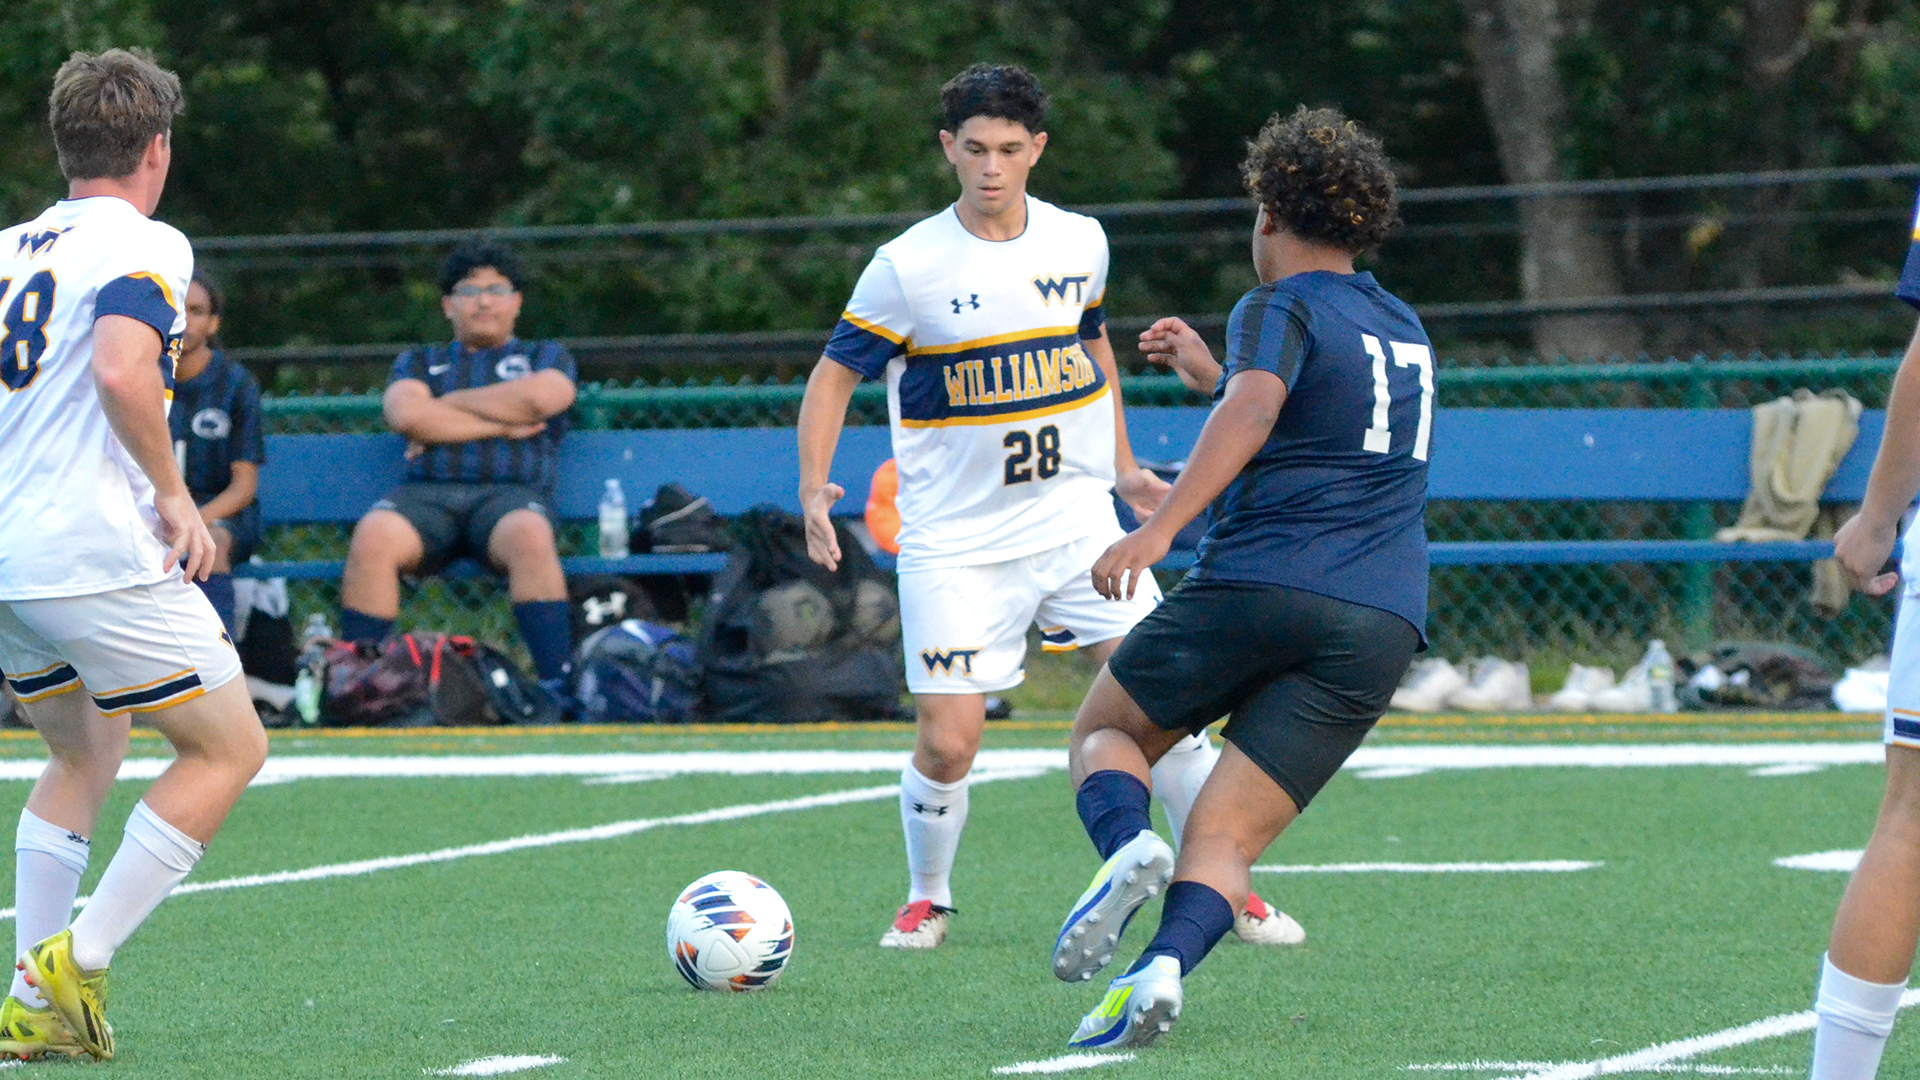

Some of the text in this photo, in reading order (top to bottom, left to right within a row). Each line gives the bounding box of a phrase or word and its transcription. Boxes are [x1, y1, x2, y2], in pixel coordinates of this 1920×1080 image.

[1030, 272, 1092, 307] WT
[0, 268, 58, 393] 8
[943, 342, 1096, 406] WILLIAMSON
[1361, 333, 1434, 462] 17
[1003, 424, 1061, 487] 28
[919, 646, 983, 677] WT
